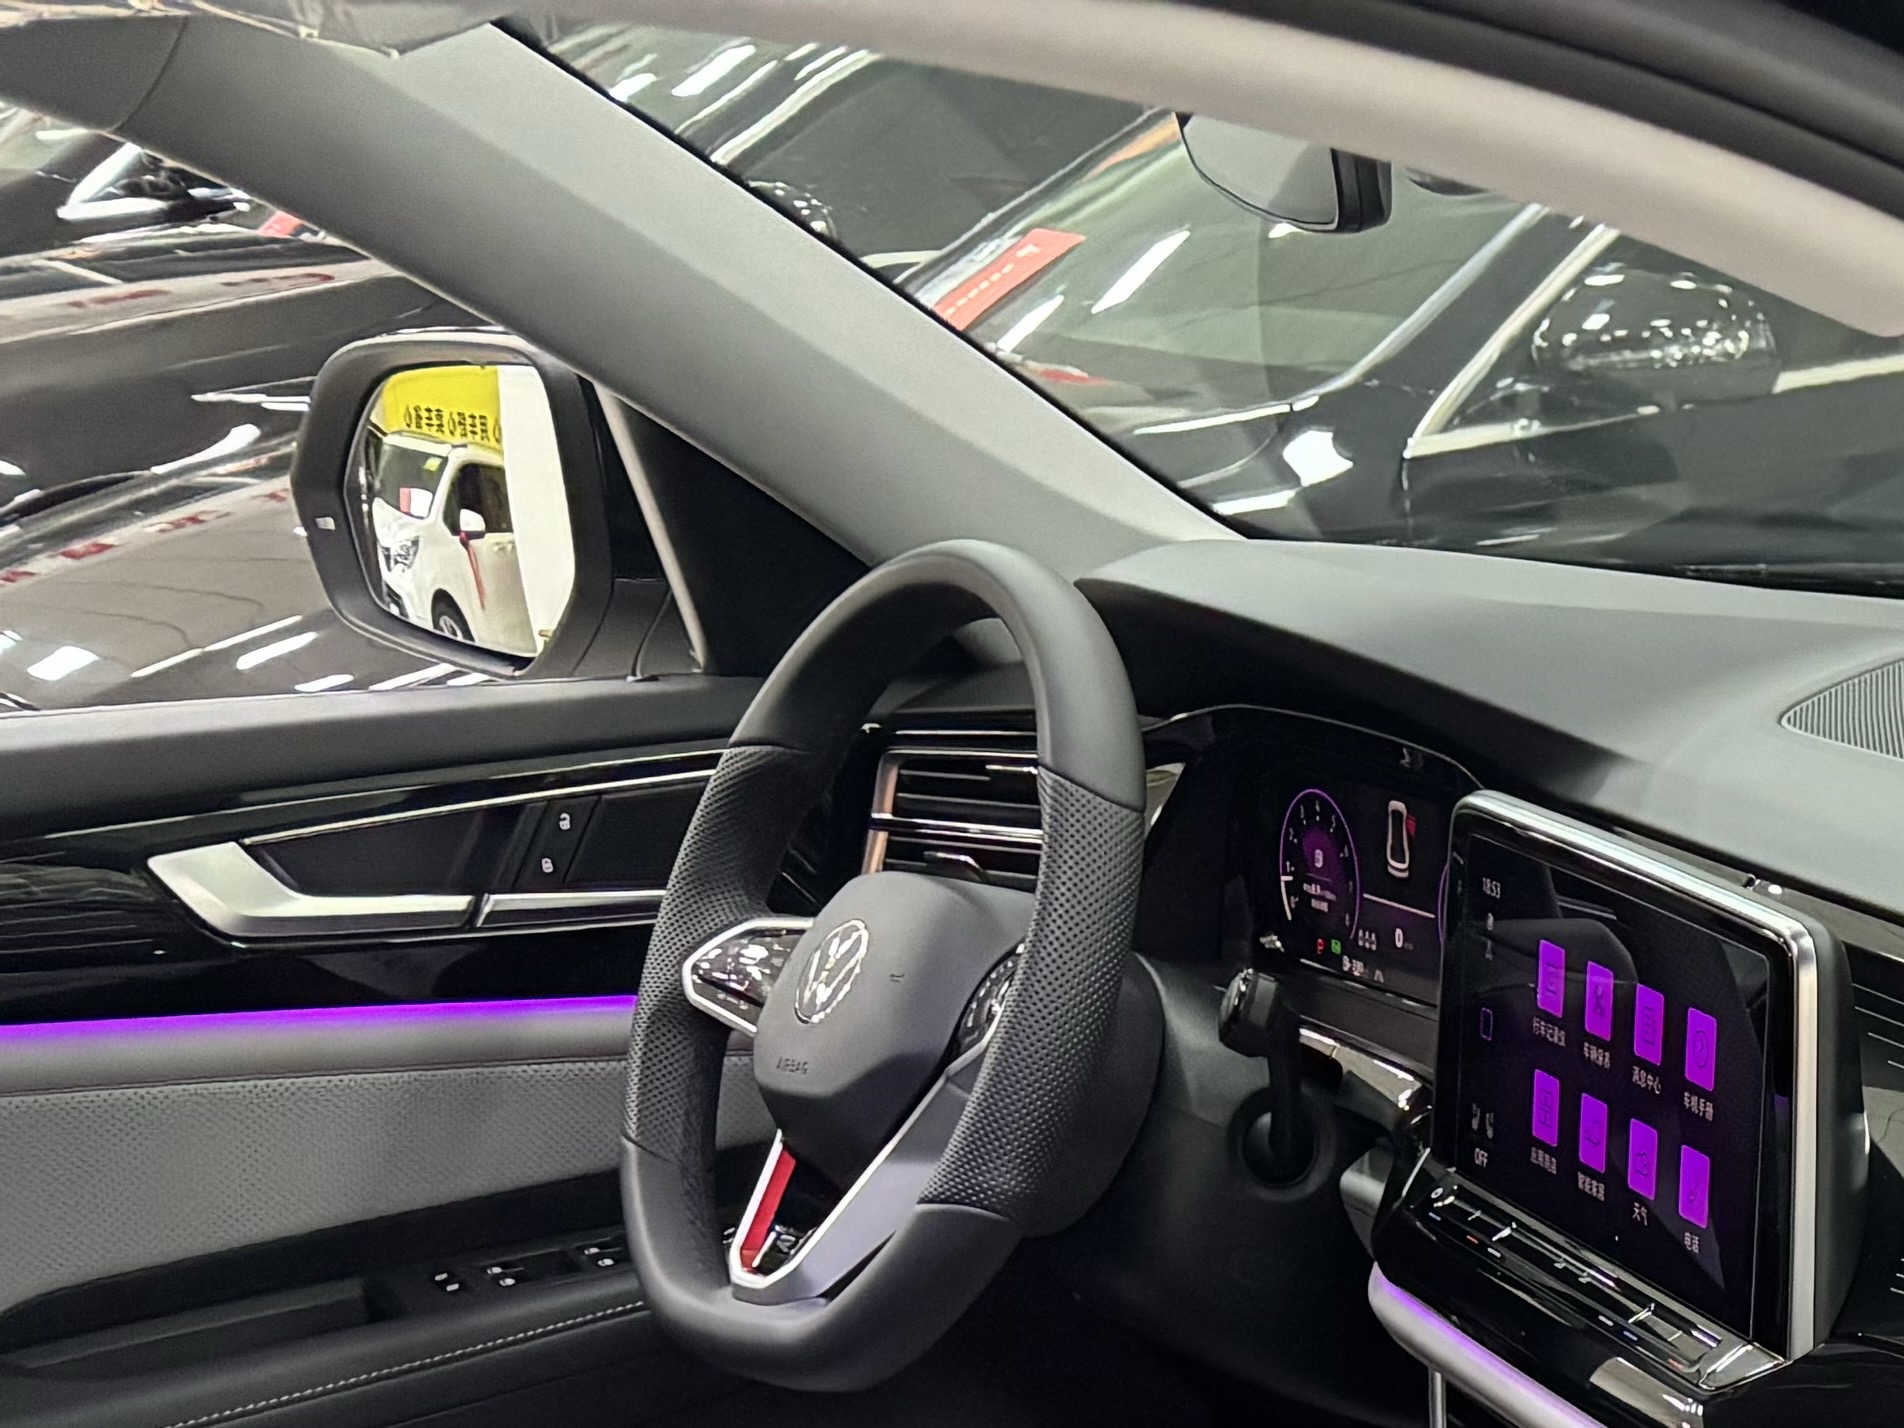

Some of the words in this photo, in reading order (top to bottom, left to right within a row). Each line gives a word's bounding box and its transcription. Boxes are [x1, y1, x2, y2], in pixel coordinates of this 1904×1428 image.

[1631, 1065, 1662, 1095] 消息中心
[1474, 1147, 1489, 1169] OFF
[1632, 1202, 1648, 1226] 天气
[1684, 1231, 1700, 1254] 电话
